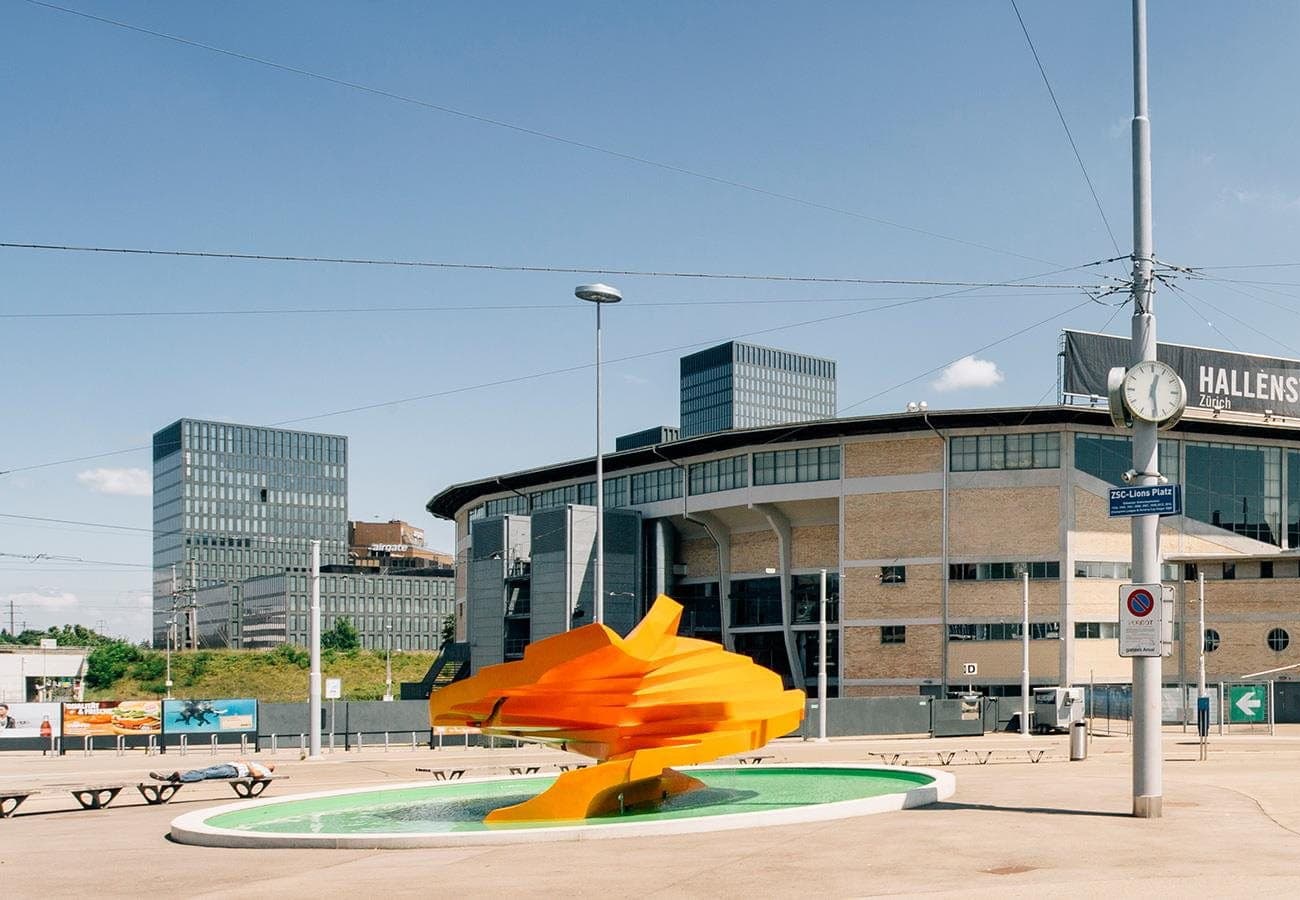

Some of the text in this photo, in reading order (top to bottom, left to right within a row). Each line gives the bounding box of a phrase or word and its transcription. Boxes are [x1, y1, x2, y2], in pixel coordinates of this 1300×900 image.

[1200, 393, 1231, 410] Zürich
[1111, 488, 1172, 499] ZSC-Lions Platz
[371, 543, 408, 552] airgate
[967, 664, 976, 674] D
